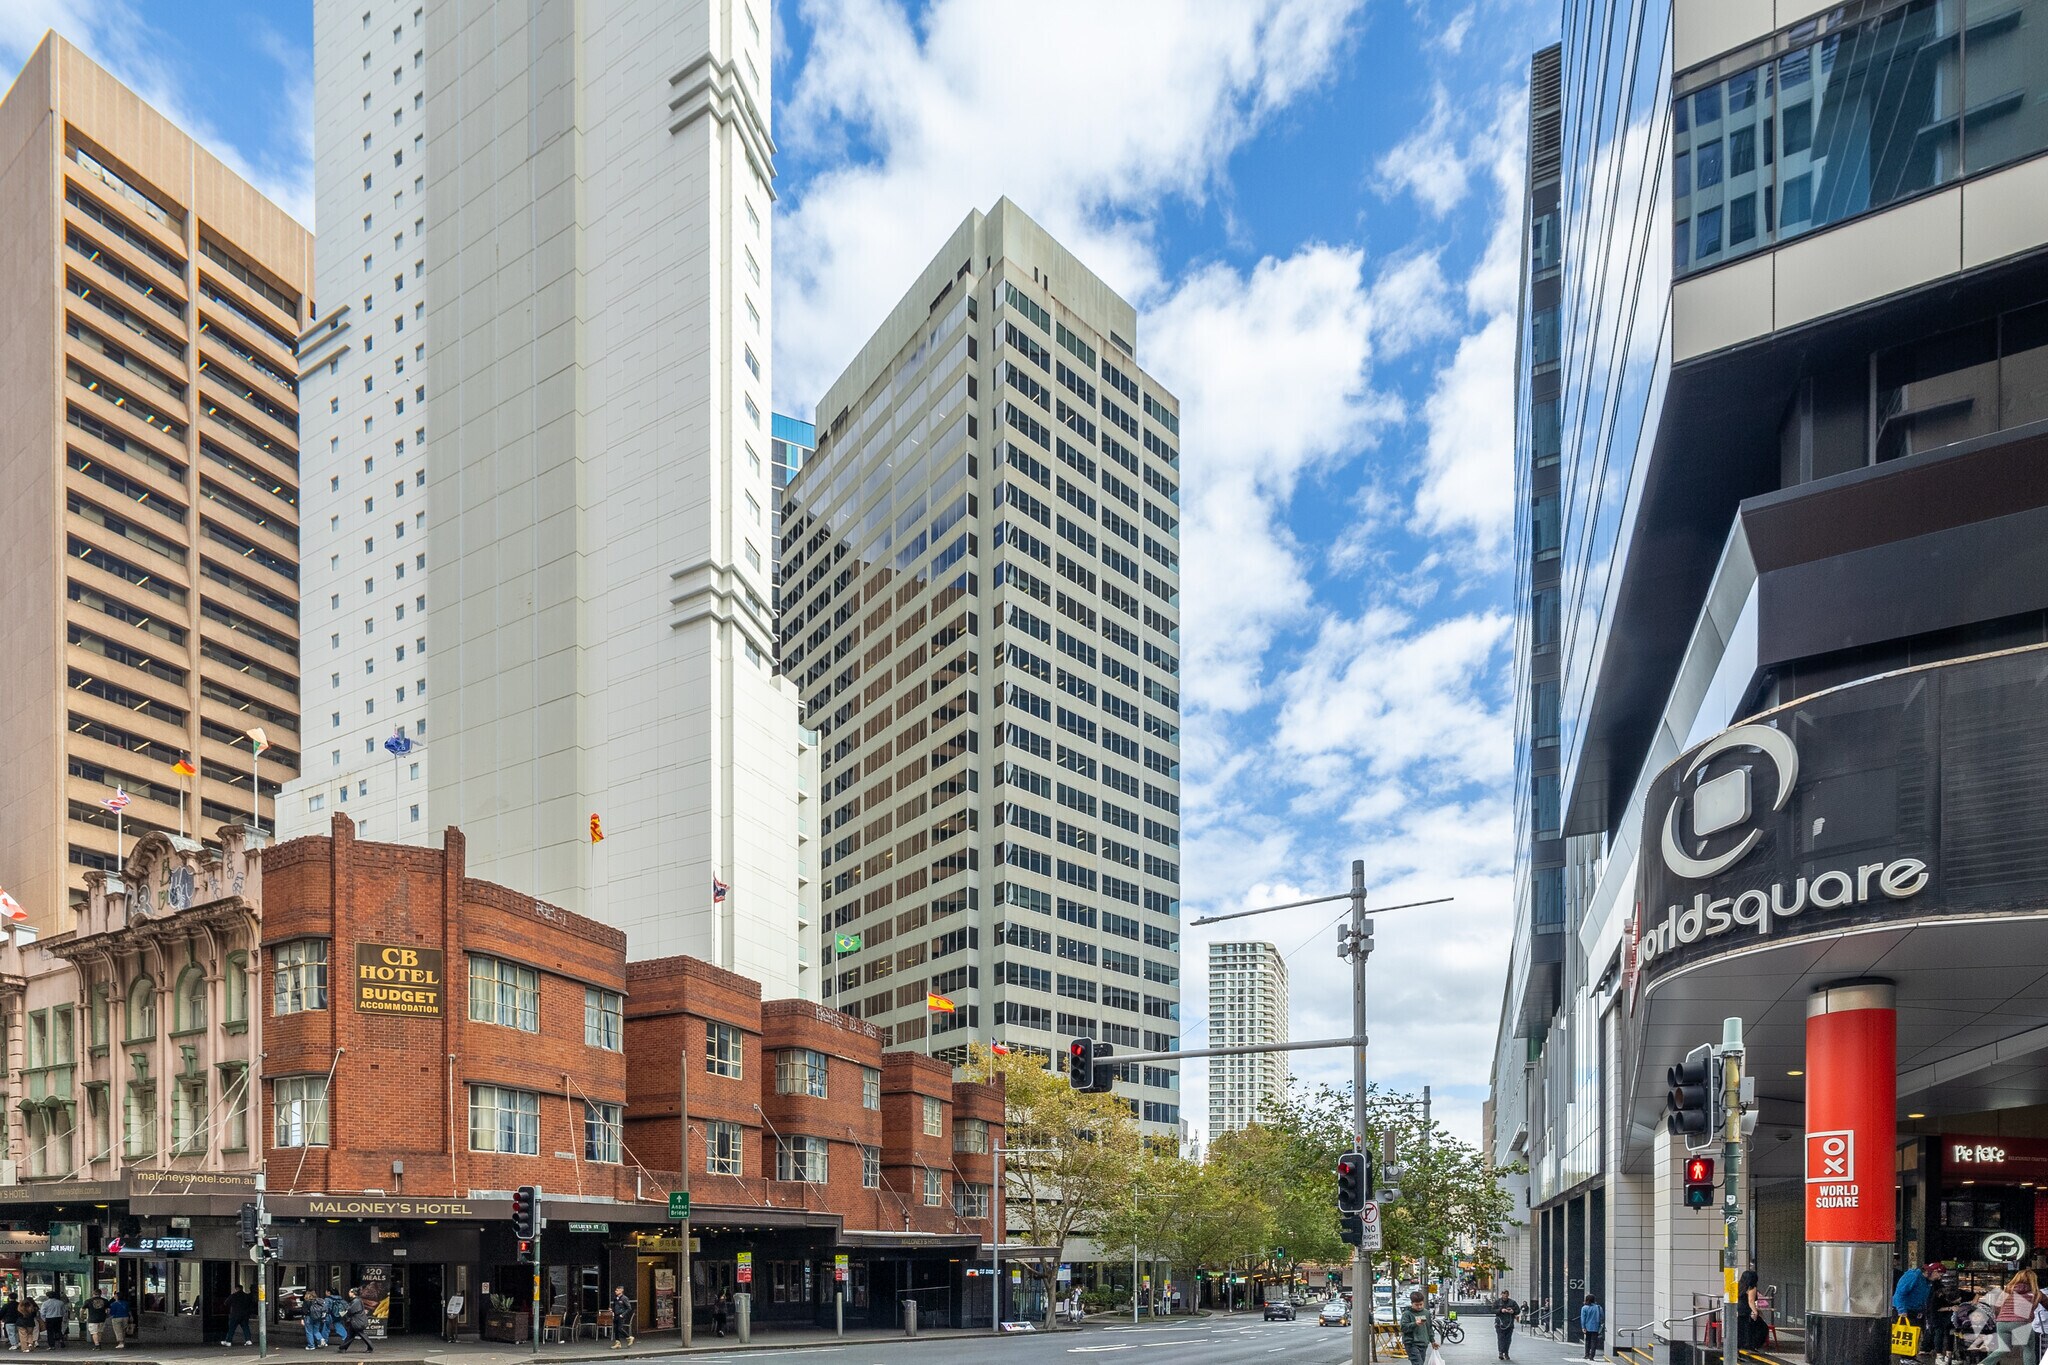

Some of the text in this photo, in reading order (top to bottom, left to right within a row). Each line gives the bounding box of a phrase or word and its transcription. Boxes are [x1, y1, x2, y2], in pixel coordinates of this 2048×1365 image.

[381, 947, 419, 967] CB
[359, 965, 440, 984] HOTEL
[362, 987, 437, 1004] BUDGET
[360, 1001, 439, 1014] ACCOMMODATION
[137, 1171, 256, 1185] maloneyshotel.com.au
[9, 1189, 30, 1198] HOTEL
[1819, 1184, 1859, 1196] WORLD
[1815, 1196, 1859, 1208] SQUARE
[309, 1202, 473, 1215] MALONEY'S HOTEL
[1365, 1224, 1376, 1233] NO
[140, 1239, 193, 1249] $5 DRINKS
[1569, 1278, 1585, 1290] 52
[1892, 1331, 1913, 1341] JB
